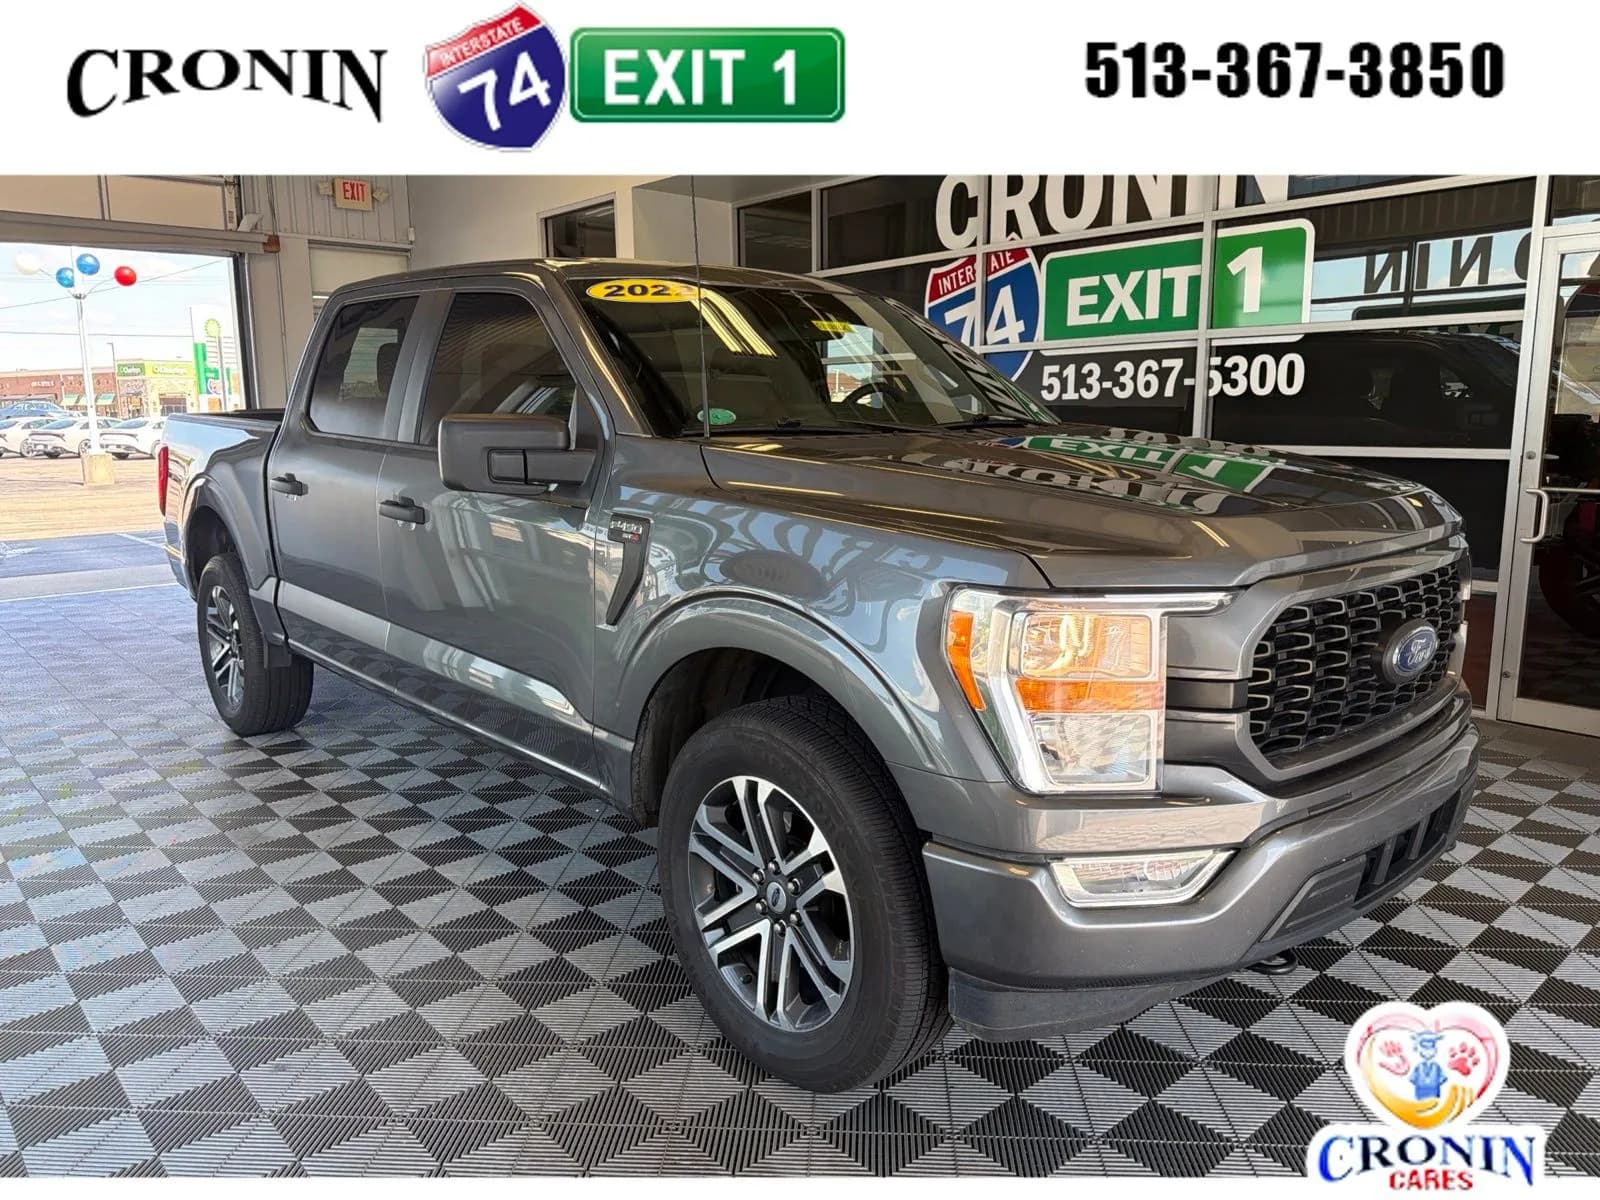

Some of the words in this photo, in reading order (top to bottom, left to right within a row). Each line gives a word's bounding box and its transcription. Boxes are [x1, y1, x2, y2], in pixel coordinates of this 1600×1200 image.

[343, 181, 366, 202] EXIT
[1067, 264, 1202, 327] EXIT
[1227, 246, 1263, 313] 1
[944, 285, 1025, 345] 74
[1041, 353, 1305, 401] 513-367-5300
[1405, 638, 1433, 667] Ford
